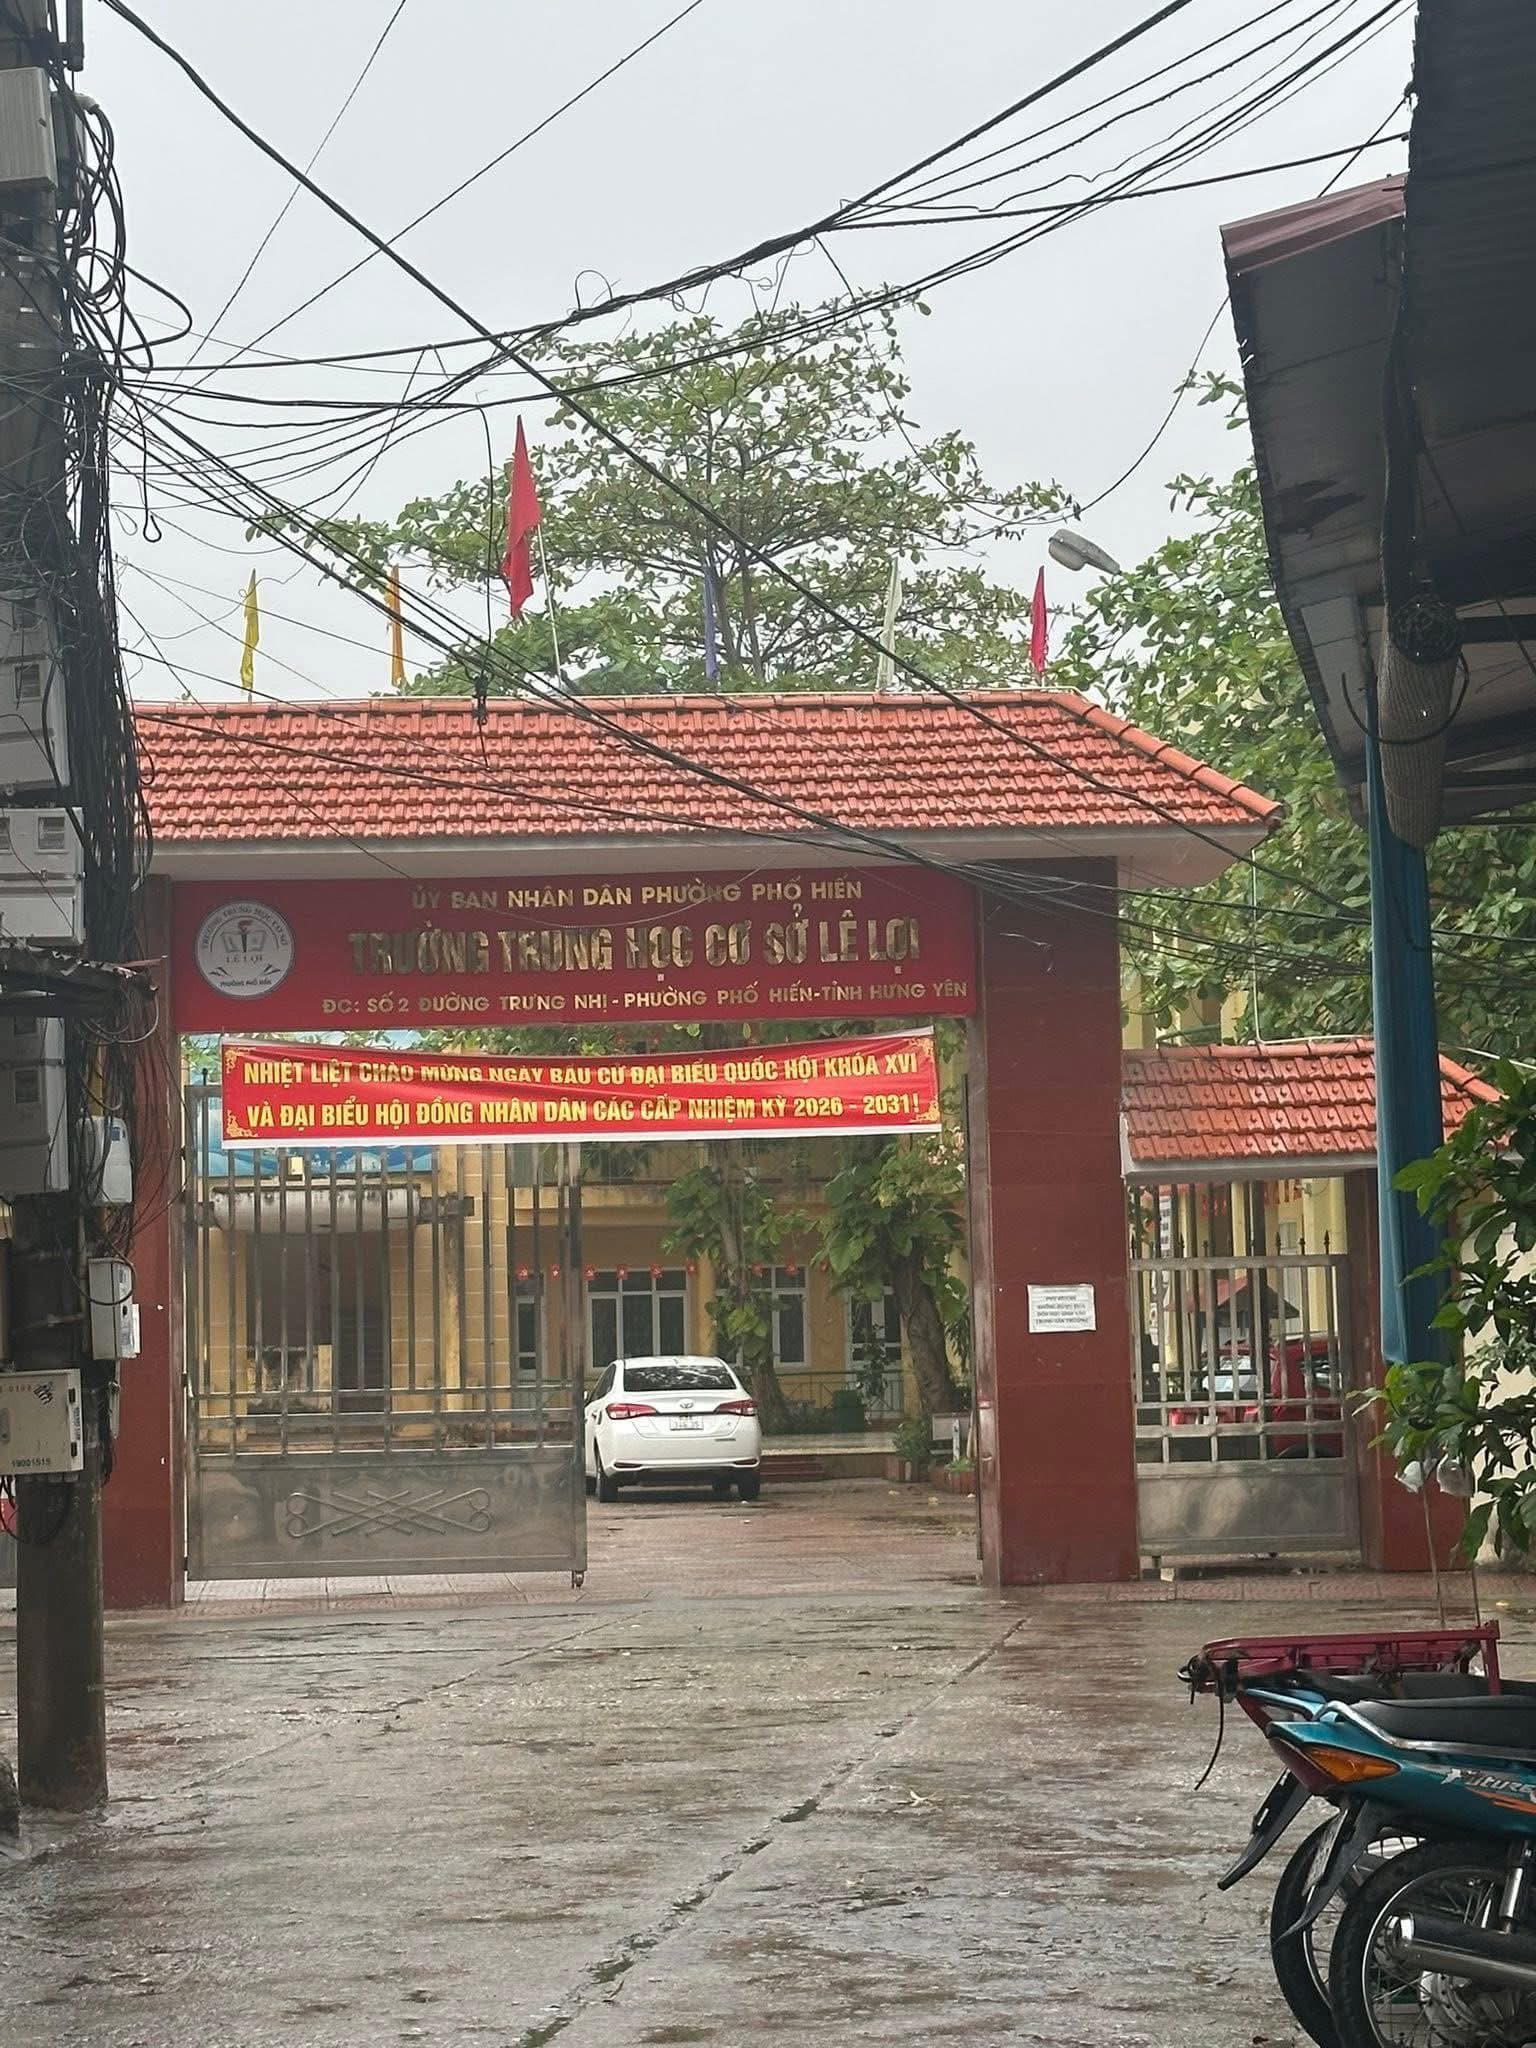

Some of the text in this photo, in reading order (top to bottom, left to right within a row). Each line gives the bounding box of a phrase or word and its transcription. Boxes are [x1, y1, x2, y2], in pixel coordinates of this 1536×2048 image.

[411, 874, 862, 909] ỦY BAN NHÂN DÂN PHƯỜNG PHỐ HIẾN
[349, 903, 919, 982] TRƯỜNG TRUNG HỌC CƠ SỞ LÊ LỢI
[322, 999, 360, 1014] ĐC:
[367, 991, 394, 1013] SỐ
[398, 998, 409, 1012] 2
[419, 991, 490, 1013] ĐƯỜNG
[574, 994, 608, 1012] NHỊ
[624, 986, 707, 1008] PHƯỜNG
[717, 981, 759, 1004] PHỐ
[870, 983, 926, 1000] HƯNG
[933, 979, 967, 998] YÊN
[244, 1058, 305, 1089] NHIỆT
[311, 1058, 352, 1088] LIỆT
[359, 1061, 414, 1083] CHÀO
[420, 1063, 482, 1083] MỪNG
[489, 1063, 543, 1084] NGÀY
[630, 1066, 665, 1088] ĐẠI
[671, 1058, 718, 1085] BIỂU
[724, 1056, 778, 1084] QUỐC
[784, 1056, 818, 1083] HỘI
[824, 1053, 879, 1078] KHÓA
[884, 1053, 918, 1074] XVI
[247, 1100, 274, 1128] VÀ
[280, 1104, 315, 1131] ĐẠI
[321, 1096, 369, 1126] BIỂU
[375, 1099, 410, 1130] HỘI
[416, 1096, 473, 1124] ĐỒNG
[479, 1097, 538, 1123] NHÂN
[544, 1097, 587, 1122] DÂN
[593, 1096, 634, 1121] CÁC
[641, 1093, 681, 1120] CẤP
[688, 1097, 756, 1123] NHIỆM
[761, 1094, 788, 1118] KỲ
[793, 1097, 844, 1118] 2026
[863, 1093, 921, 1115] 2031!
